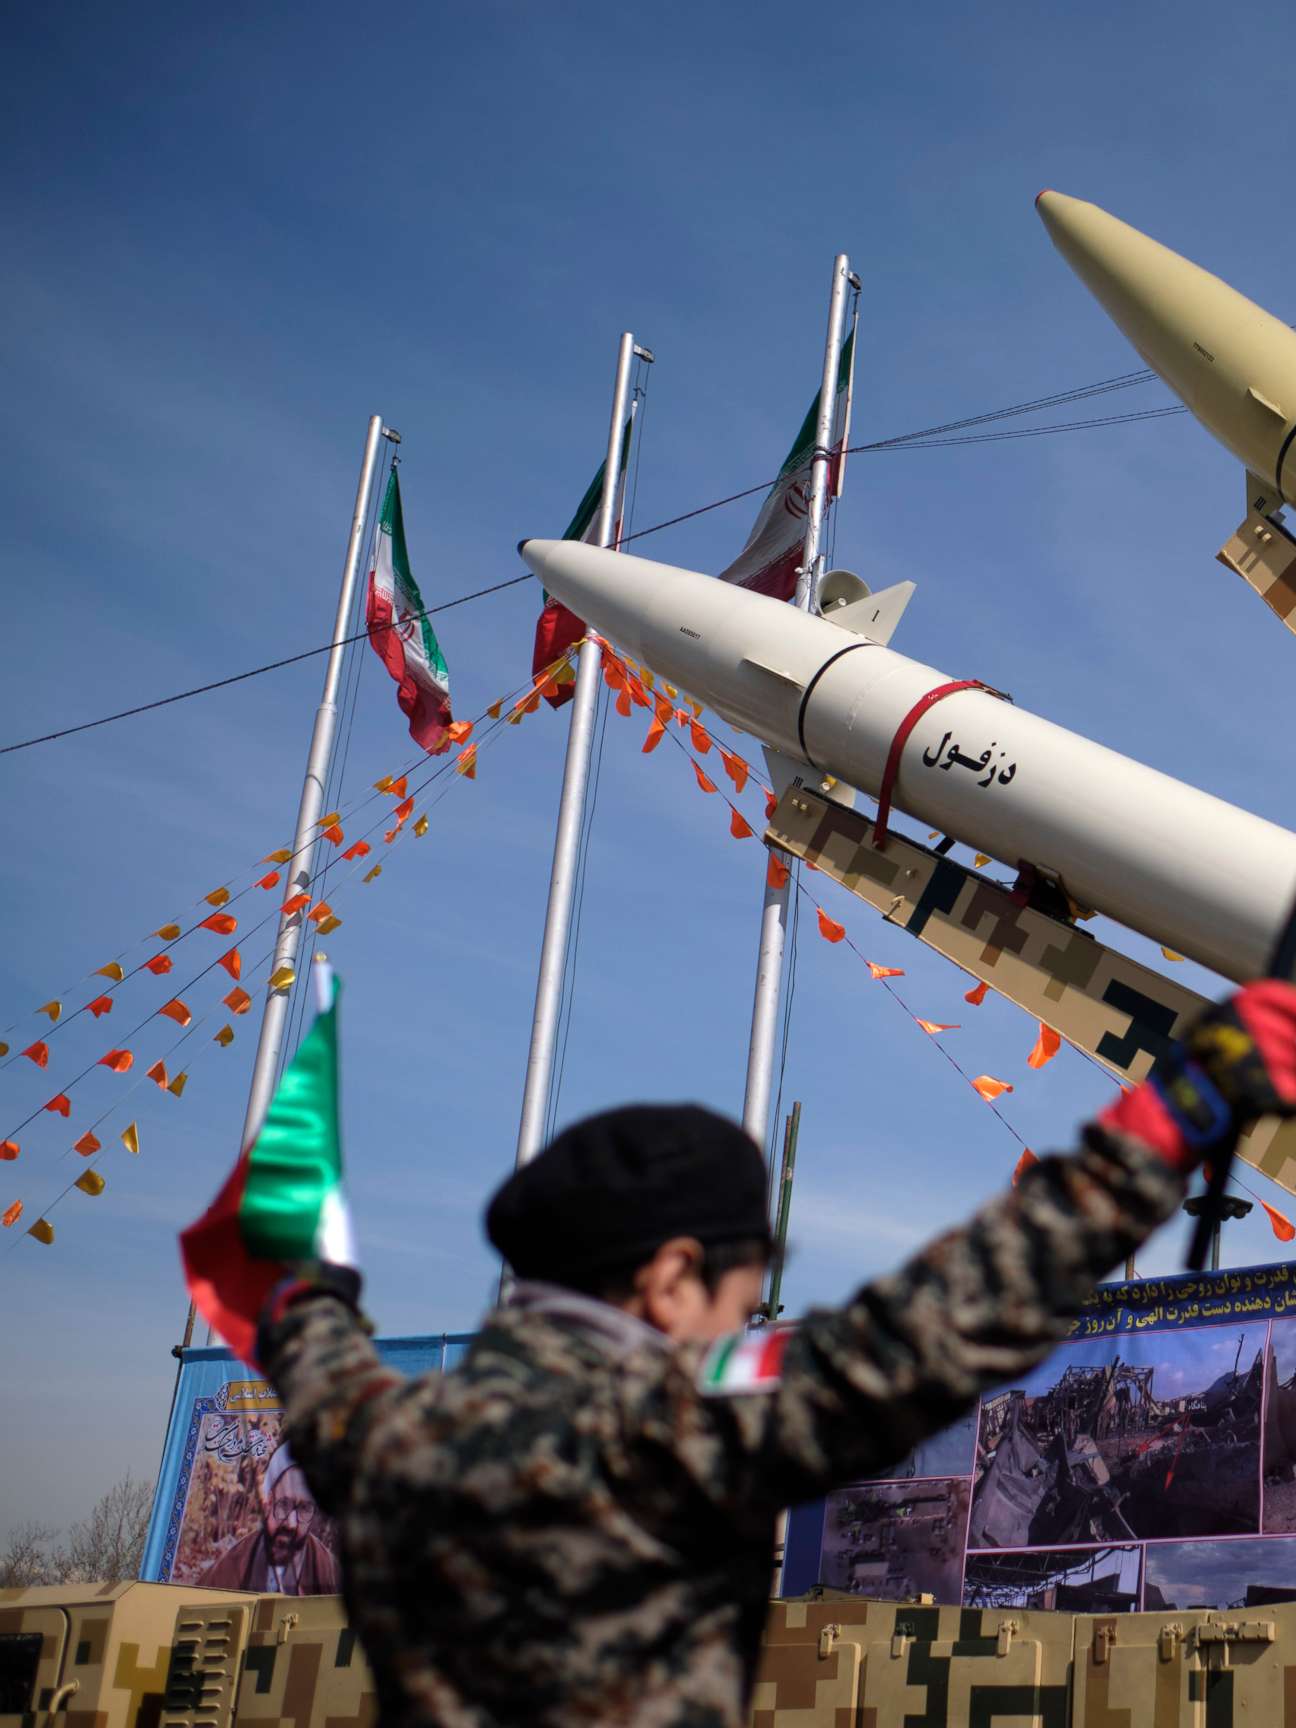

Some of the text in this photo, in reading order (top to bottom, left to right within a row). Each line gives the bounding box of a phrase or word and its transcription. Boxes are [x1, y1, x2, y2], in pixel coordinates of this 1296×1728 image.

[922, 731, 1017, 788] دزفول
[1215, 1272, 1241, 1294] توان
[1254, 1264, 1289, 1289] قدرت
[1161, 1281, 1174, 1301] را
[1166, 1303, 1200, 1324] قدرت
[1202, 1300, 1231, 1317] دست
[1234, 1296, 1272, 1313] دهنده
[1085, 1315, 1105, 1334] روز
[1106, 1307, 1123, 1330] آن
[1126, 1314, 1133, 1329] و
[1135, 1306, 1164, 1328] الهی
